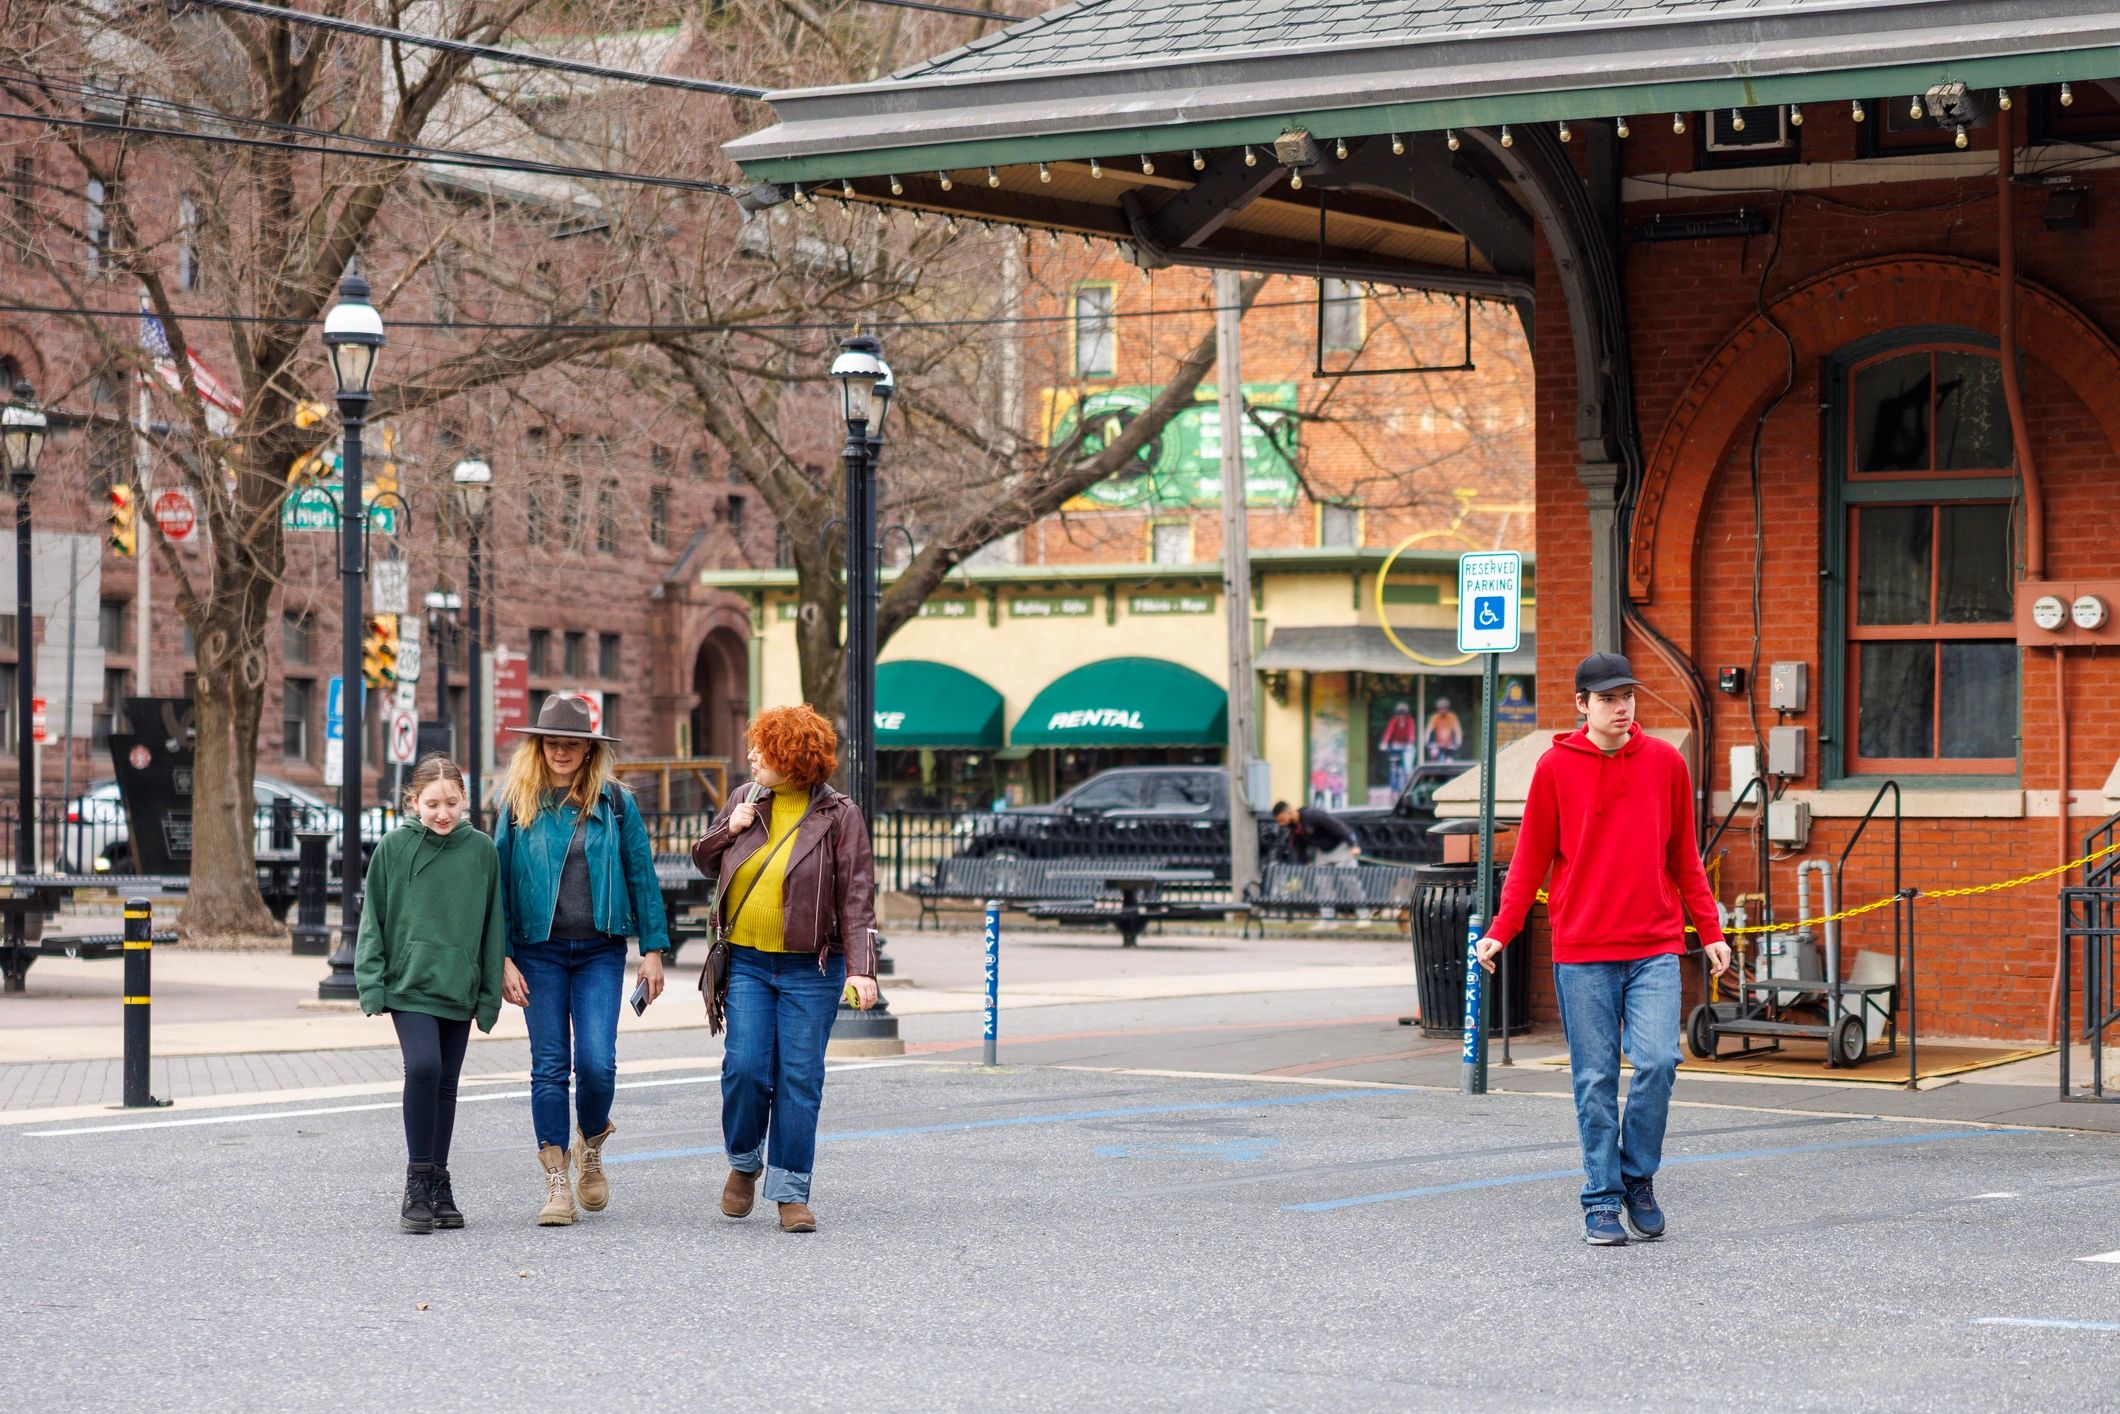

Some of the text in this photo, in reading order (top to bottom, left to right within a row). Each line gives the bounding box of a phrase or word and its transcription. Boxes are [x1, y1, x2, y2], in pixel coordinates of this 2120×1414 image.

[1465, 561, 1516, 576] RESERVED
[1467, 579, 1513, 592] PARKING
[400, 648, 419, 672] 209
[1048, 708, 1144, 731] RENTAL
